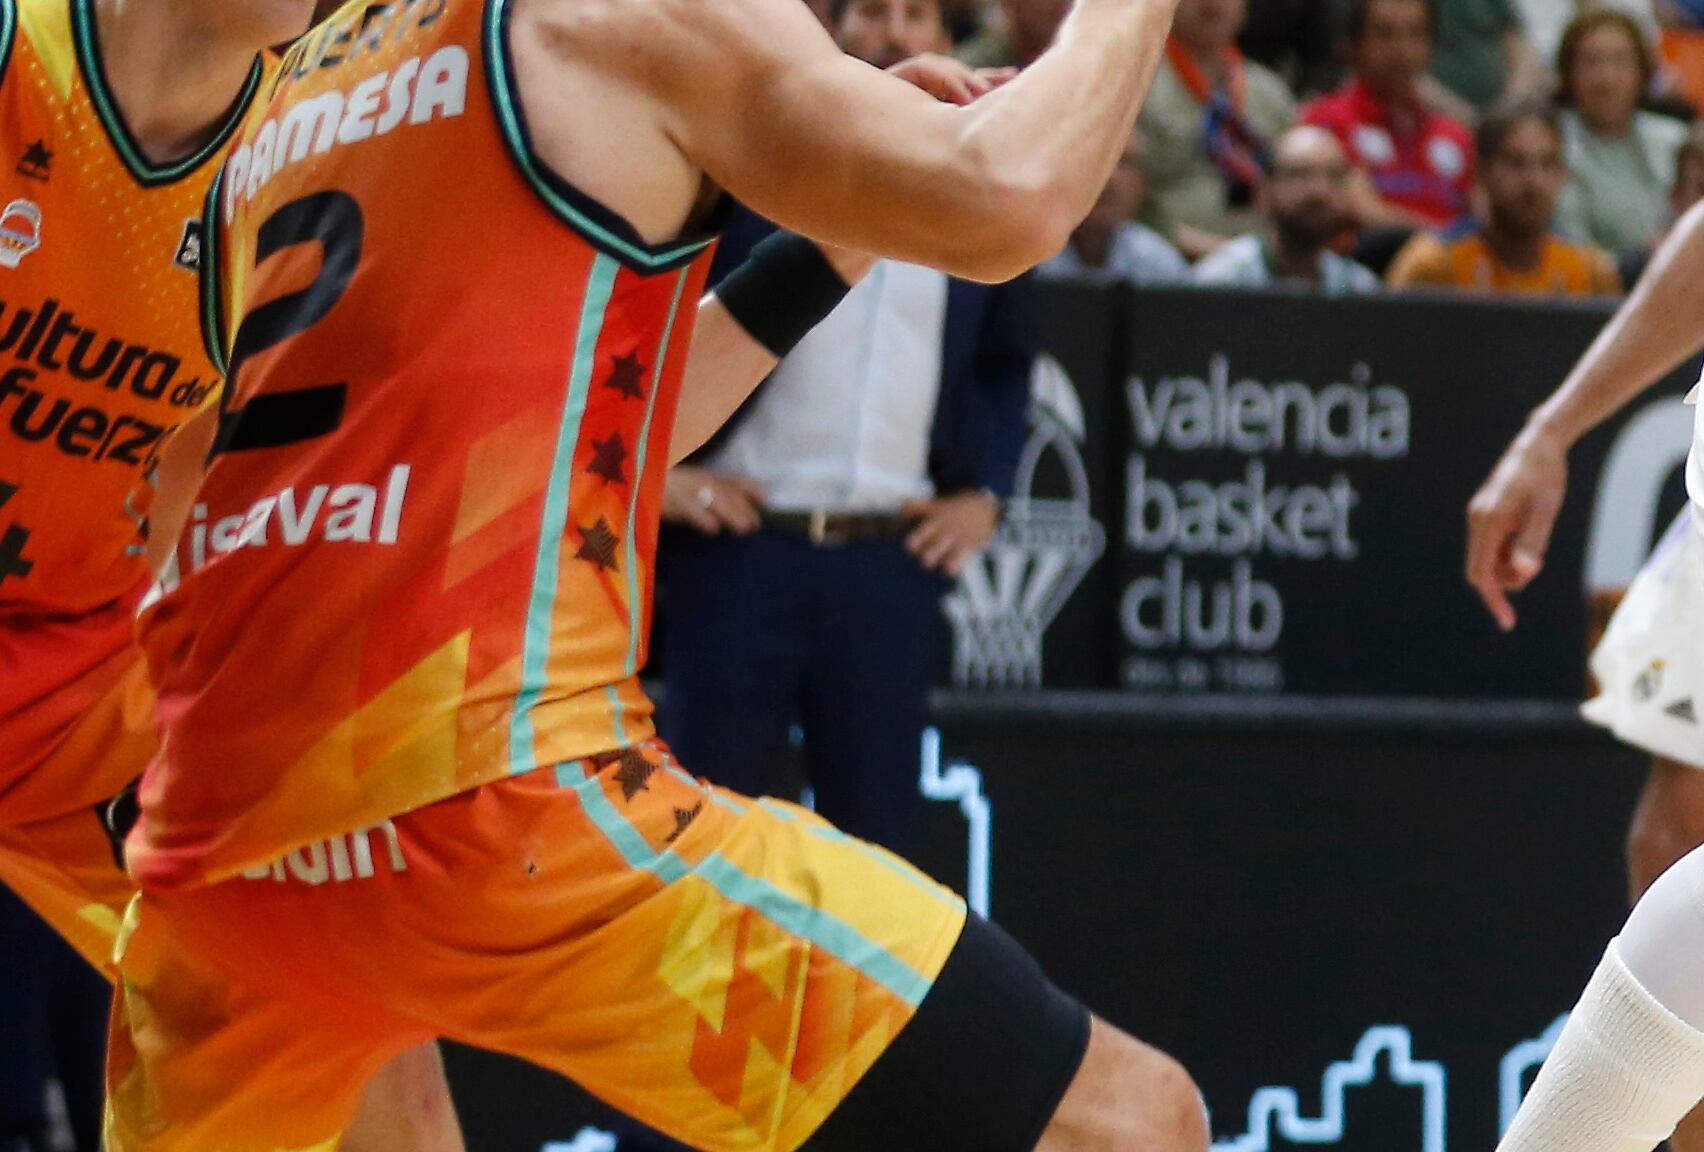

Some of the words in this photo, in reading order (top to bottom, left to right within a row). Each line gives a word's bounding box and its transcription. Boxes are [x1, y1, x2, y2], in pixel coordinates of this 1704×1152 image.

[224, 45, 469, 225] PAMESA
[212, 190, 365, 464] 2
[1125, 350, 1411, 457] valencia
[1124, 453, 1361, 562] basket
[1120, 554, 1284, 650] club
